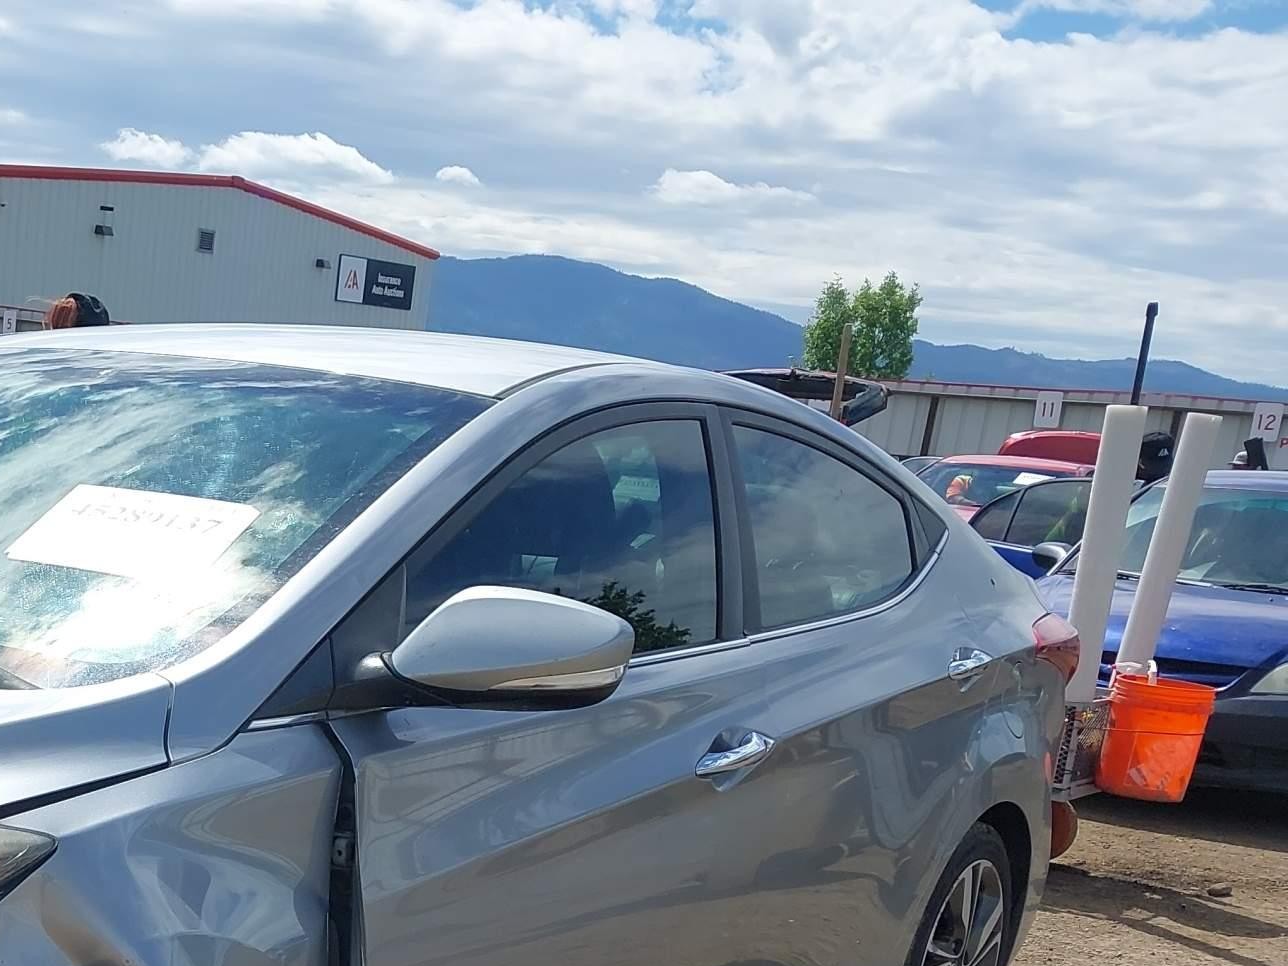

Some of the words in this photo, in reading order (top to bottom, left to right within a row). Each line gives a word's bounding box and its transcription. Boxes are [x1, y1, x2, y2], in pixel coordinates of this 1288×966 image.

[377, 272, 402, 286] Insurance
[371, 284, 384, 296] Auto
[383, 285, 405, 298] Auctions
[7, 317, 12, 330] 5
[1042, 401, 1055, 417] 11
[1257, 413, 1277, 431] 12
